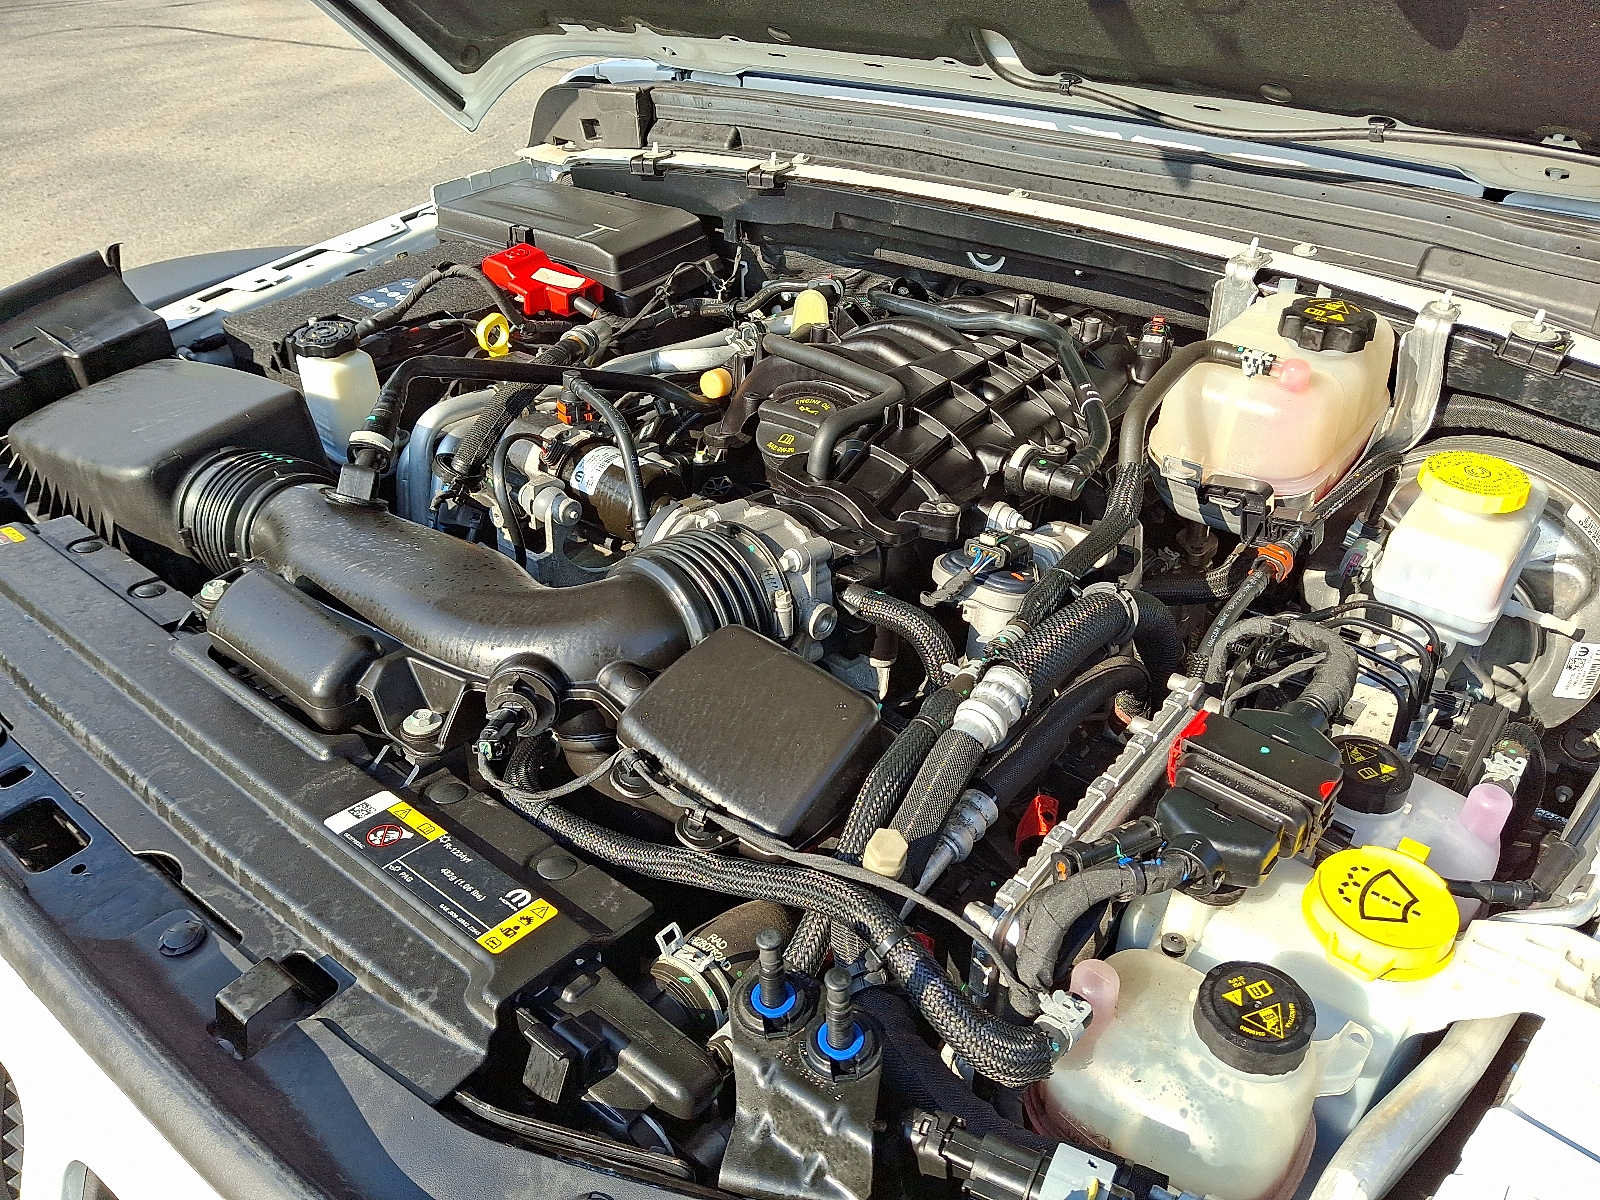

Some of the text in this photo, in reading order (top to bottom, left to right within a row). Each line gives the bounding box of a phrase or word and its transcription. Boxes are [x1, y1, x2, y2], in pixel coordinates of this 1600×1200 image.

[443, 842, 473, 864] R-1234yf
[399, 871, 414, 883] PAG
[706, 933, 728, 950] RAD
